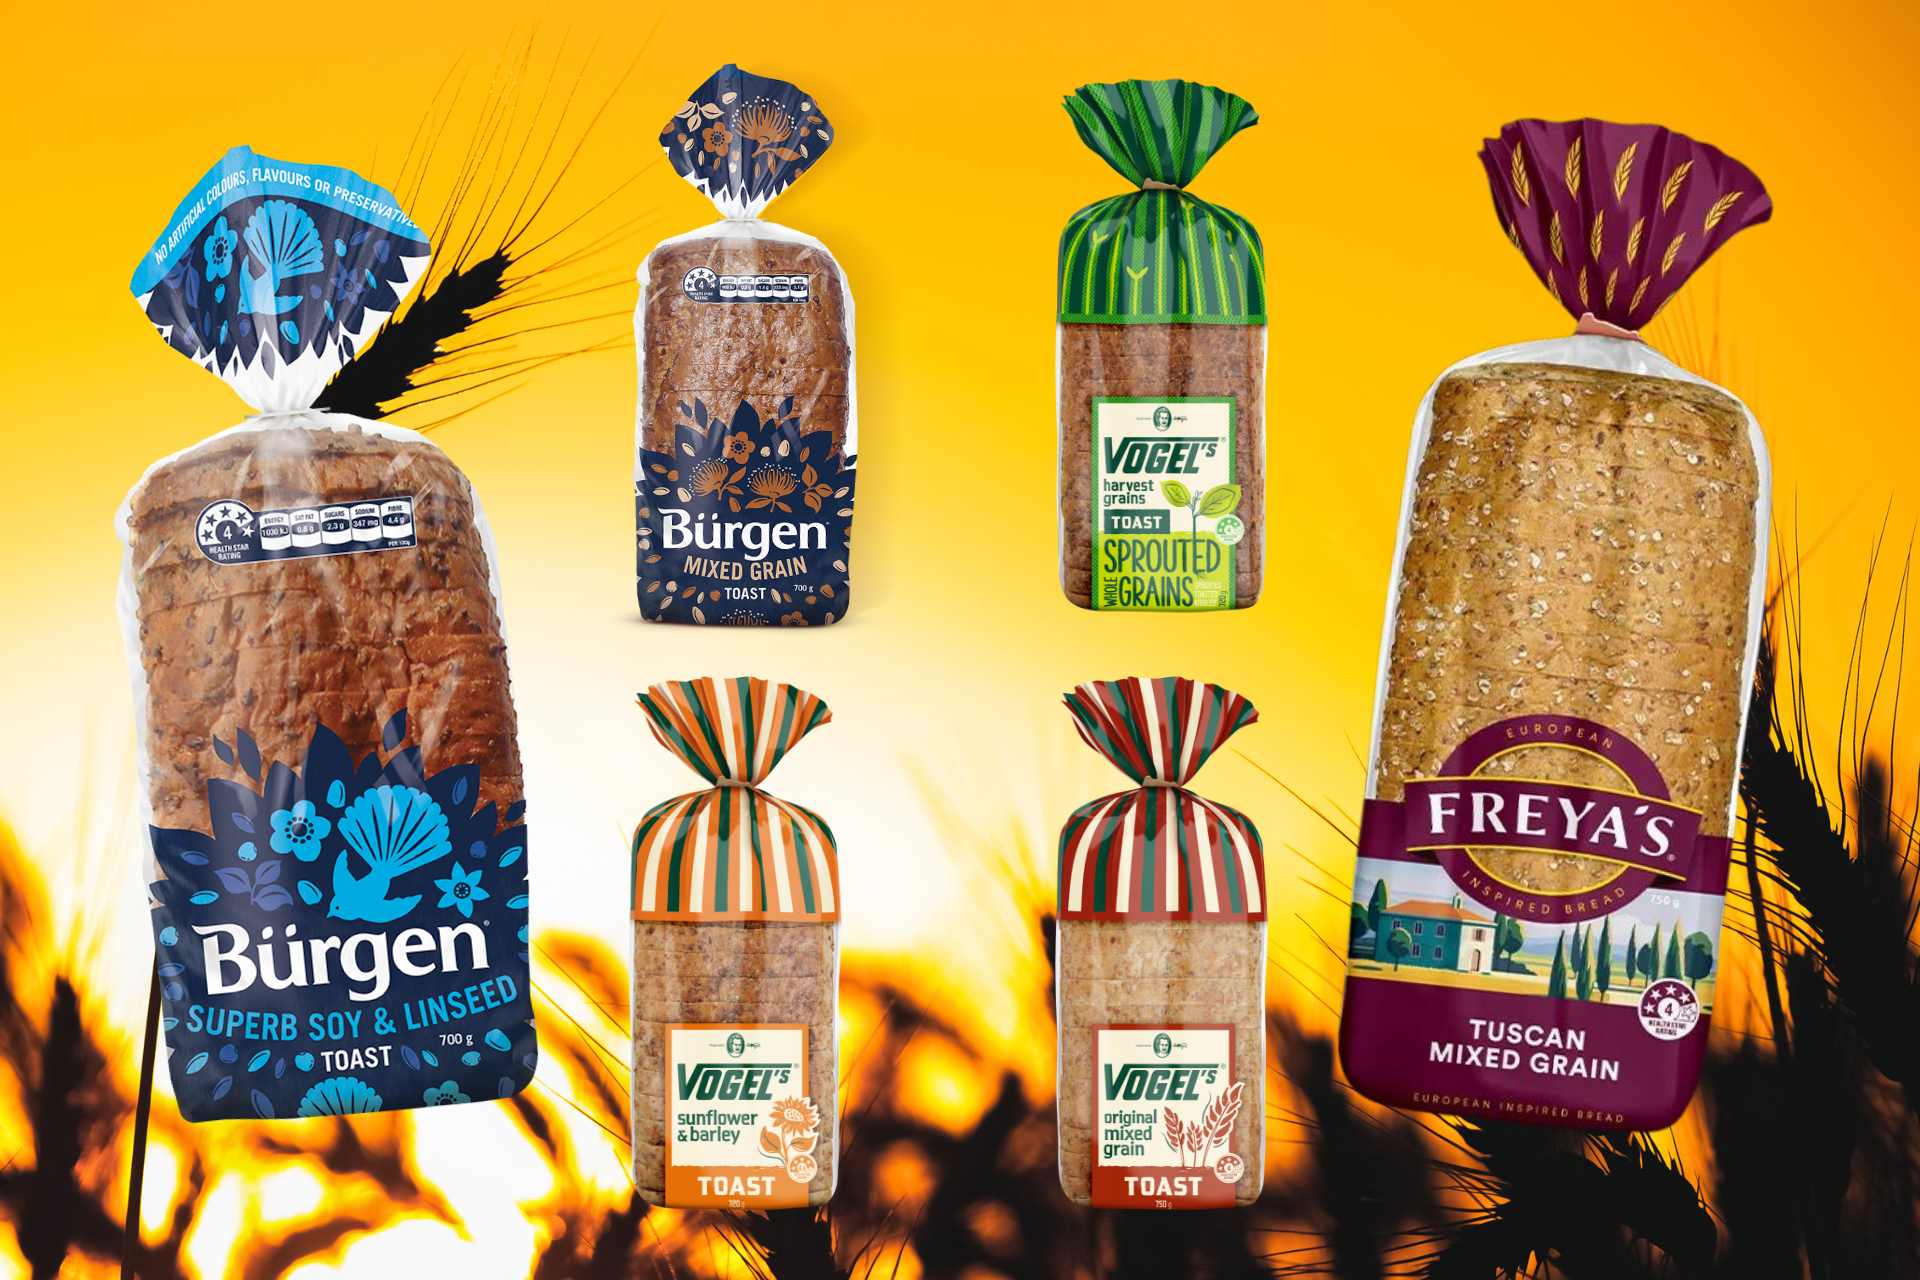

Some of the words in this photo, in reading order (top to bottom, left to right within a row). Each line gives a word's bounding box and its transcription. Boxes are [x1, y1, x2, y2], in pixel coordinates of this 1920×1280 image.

[155, 243, 168, 265] NO
[168, 198, 206, 252] ARTIFICIAL
[206, 169, 249, 205] COLOURS,
[252, 167, 311, 189] FLAVOURS
[314, 179, 331, 194] OR
[698, 281, 704, 289] 4
[1104, 437, 1219, 474] VOGEL'S
[1104, 479, 1154, 492] harvest
[1104, 492, 1146, 507] grains
[223, 526, 232, 540] 4
[353, 520, 366, 528] 347
[657, 507, 827, 561] Bürgen
[1112, 516, 1162, 529] TOAST
[1104, 538, 1221, 574] SPROUTED
[683, 555, 743, 581] MIXED
[751, 555, 808, 580] GRAIN
[724, 587, 767, 600] TOAST
[793, 584, 807, 592] 700
[809, 585, 814, 593] g
[1104, 576, 1118, 608] WHOLE
[1119, 576, 1193, 608] GRAINS
[1505, 723, 1614, 750] EUROPEAN
[1428, 792, 1674, 858] FREYA'S
[1462, 869, 1550, 915] INSPIRED
[1564, 886, 1627, 914] BREAD
[1649, 893, 1671, 907] 750
[1672, 898, 1680, 909] g
[191, 921, 490, 1002] Bürgen
[186, 1004, 298, 1042] SUPERB
[308, 1009, 362, 1041] SOY
[374, 1007, 397, 1035] &
[403, 974, 518, 1031] LINSEED
[1664, 1002, 1673, 1016] 4
[439, 1033, 463, 1047] 700
[466, 1033, 474, 1046] g
[1468, 1018, 1586, 1051] TUSCAN
[321, 1045, 393, 1073] TOAST
[1429, 1041, 1521, 1071] MIXED
[1529, 1052, 1620, 1081] GRAIN
[677, 1063, 792, 1100] VOGEL'S
[1104, 1063, 1219, 1101] VOGEL'S
[677, 1109, 758, 1126] sunflower
[1104, 1109, 1157, 1128] original
[1413, 1092, 1491, 1110] EUROPEAN
[1499, 1102, 1569, 1118] INSPIRED
[1576, 1110, 1624, 1124] BREAD
[677, 1130, 687, 1142] &
[690, 1126, 740, 1145] barley
[1104, 1126, 1152, 1141] mixed
[1104, 1142, 1144, 1159] grain
[697, 1176, 776, 1196] TOAST
[1124, 1176, 1203, 1196] TOAST
